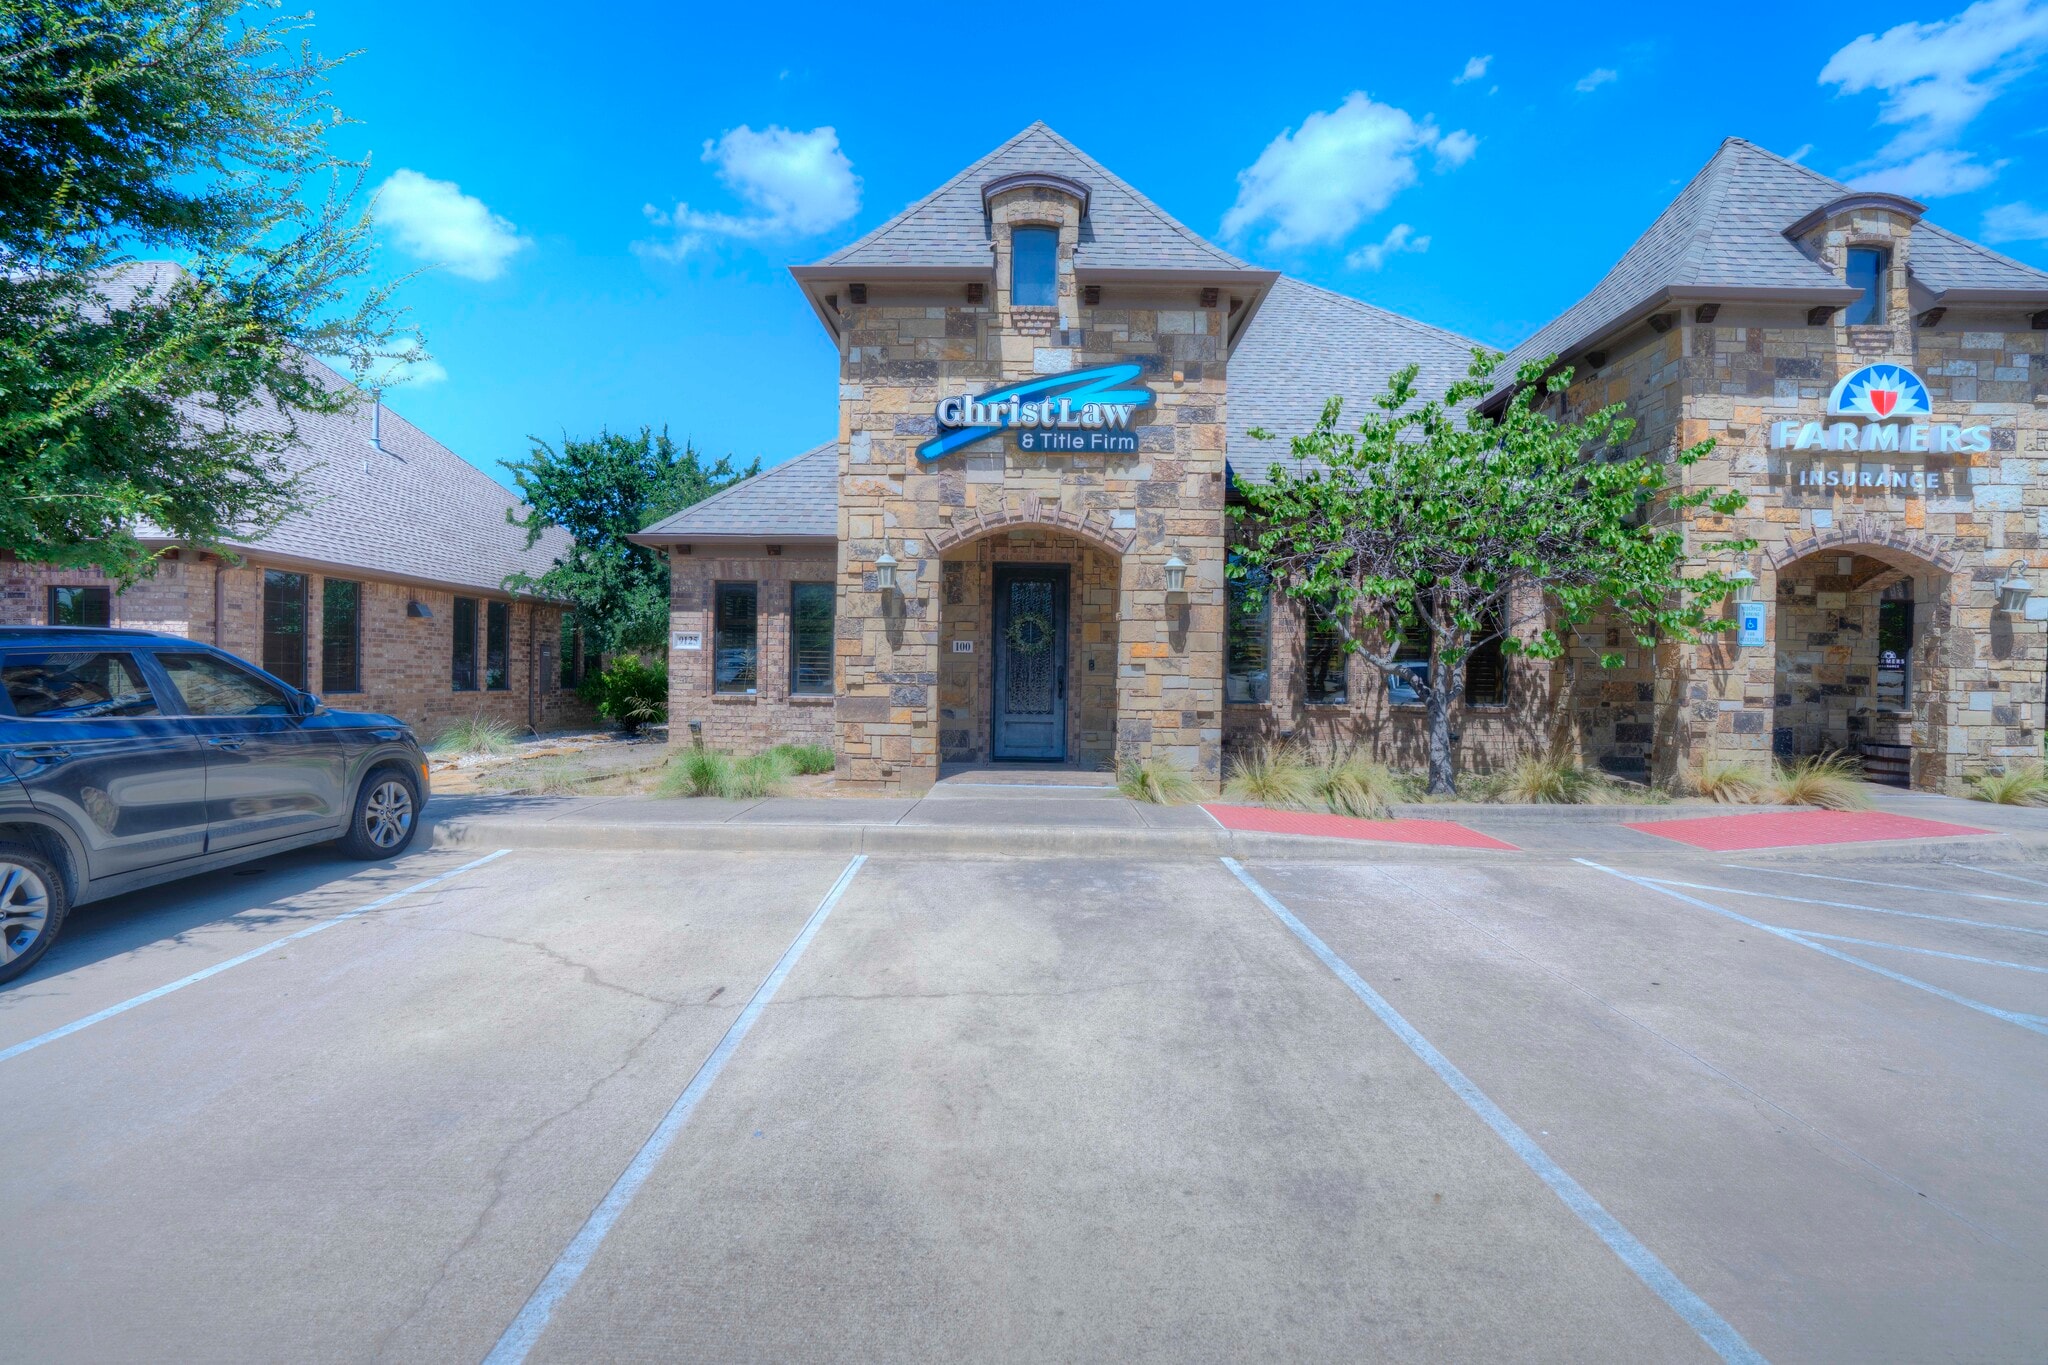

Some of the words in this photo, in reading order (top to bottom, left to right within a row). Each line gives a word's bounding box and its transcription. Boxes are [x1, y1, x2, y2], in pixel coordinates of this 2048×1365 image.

[938, 393, 1055, 428] Ghrist
[1057, 397, 1136, 429] Law
[1021, 433, 1034, 449] &
[1040, 433, 1084, 449] Title
[1091, 433, 1135, 450] Firm
[1771, 421, 1992, 453] FARMERS
[1799, 470, 1939, 488] INSURANCE
[956, 641, 971, 652] 100
